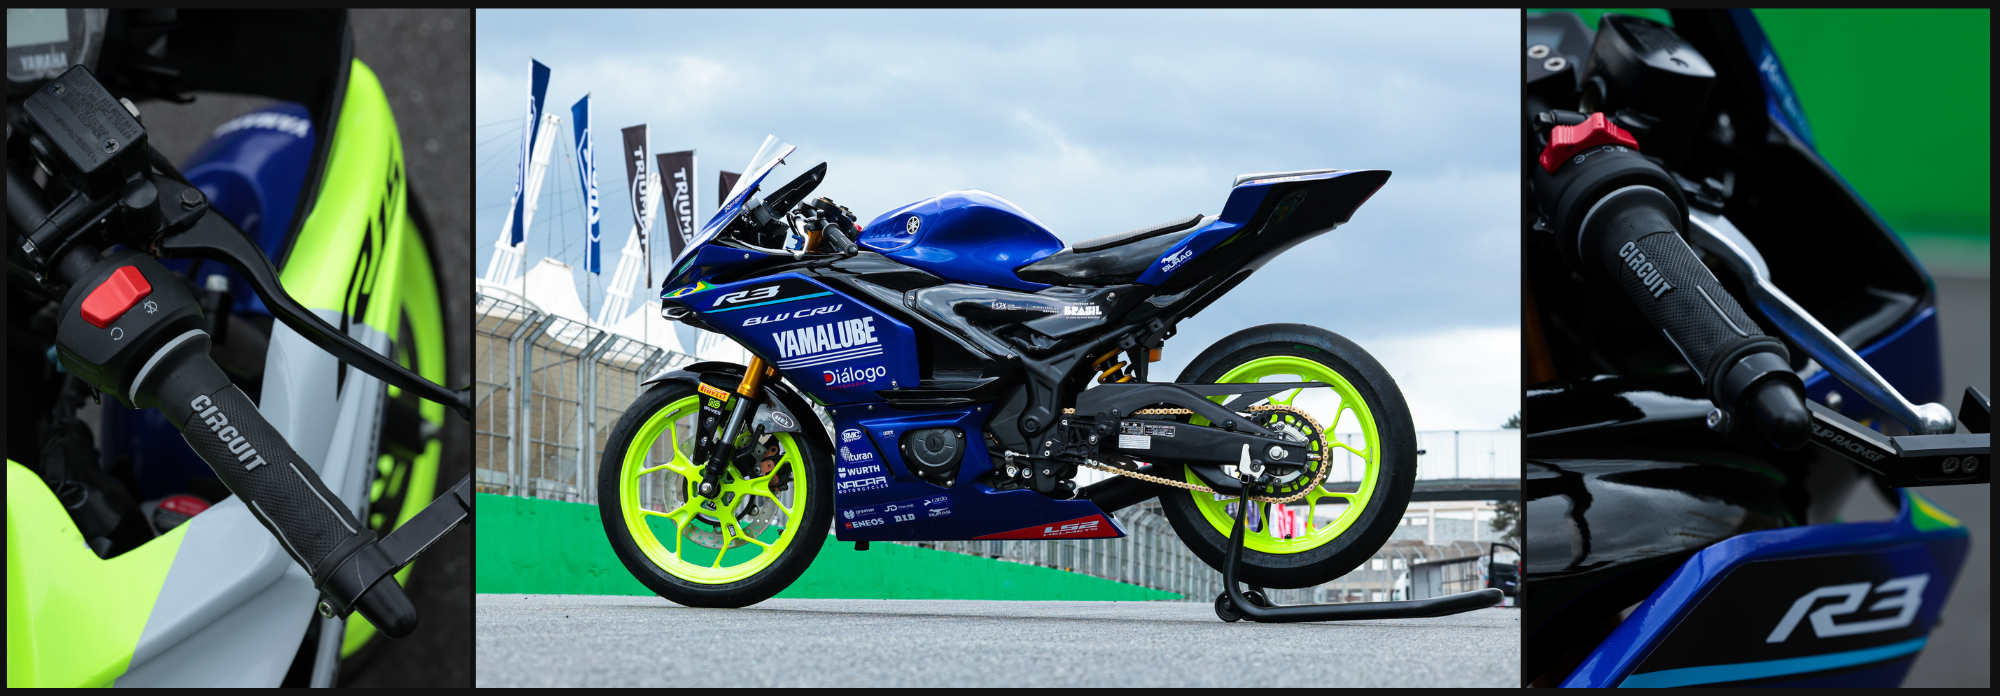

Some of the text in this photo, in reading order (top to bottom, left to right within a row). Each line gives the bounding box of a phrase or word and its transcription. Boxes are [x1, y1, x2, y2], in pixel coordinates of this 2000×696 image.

[1618, 241, 1672, 299] CIRCUIT
[712, 284, 781, 307] R3
[742, 303, 843, 327] BLU CRU
[1064, 305, 1103, 316] BRASIL
[772, 316, 878, 359] YAMALUBE
[823, 365, 887, 386] Diálogo
[700, 384, 728, 400] PIRELLI
[190, 393, 270, 472] CIRCUIT
[1831, 434, 1878, 462] RACING
[852, 517, 885, 529] ENEOS
[1044, 520, 1099, 534] LS2
[1766, 573, 1932, 643] R3
